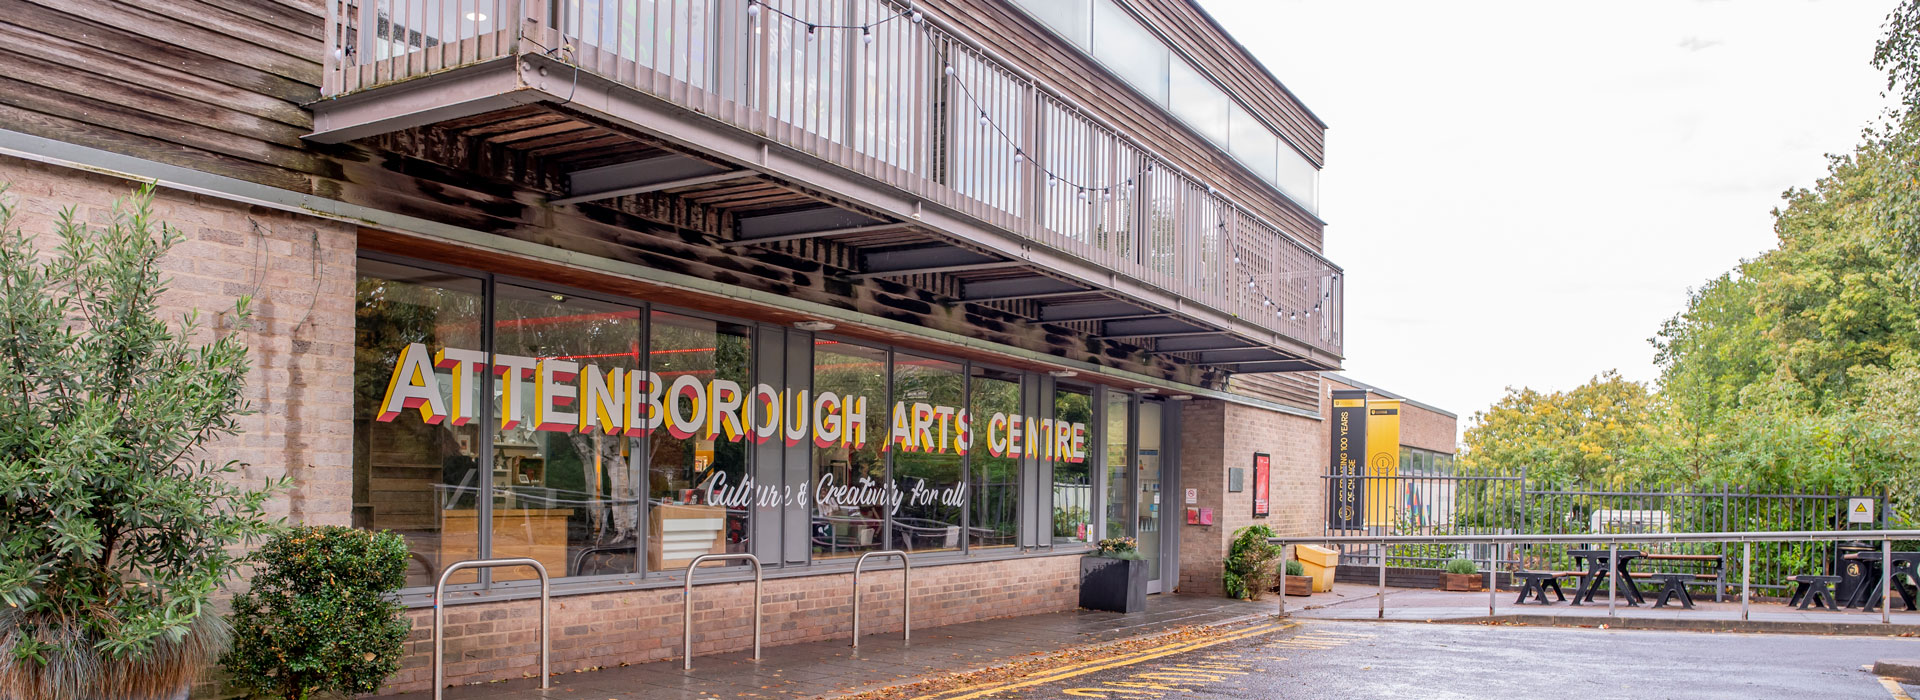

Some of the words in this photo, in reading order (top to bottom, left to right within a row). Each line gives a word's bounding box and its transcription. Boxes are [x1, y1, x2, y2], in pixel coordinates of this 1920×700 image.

[376, 342, 867, 449] ATTENBOROUGH
[882, 401, 974, 456] ARTS
[986, 411, 1085, 463] CENTRE
[1341, 411, 1349, 436] YEARS
[1340, 437, 1348, 451] 100
[1348, 459, 1356, 490] CHNGE
[707, 470, 793, 507] Culture
[797, 480, 809, 509] &
[816, 472, 904, 515] Creativity
[911, 478, 938, 506] for
[942, 481, 966, 507] all
